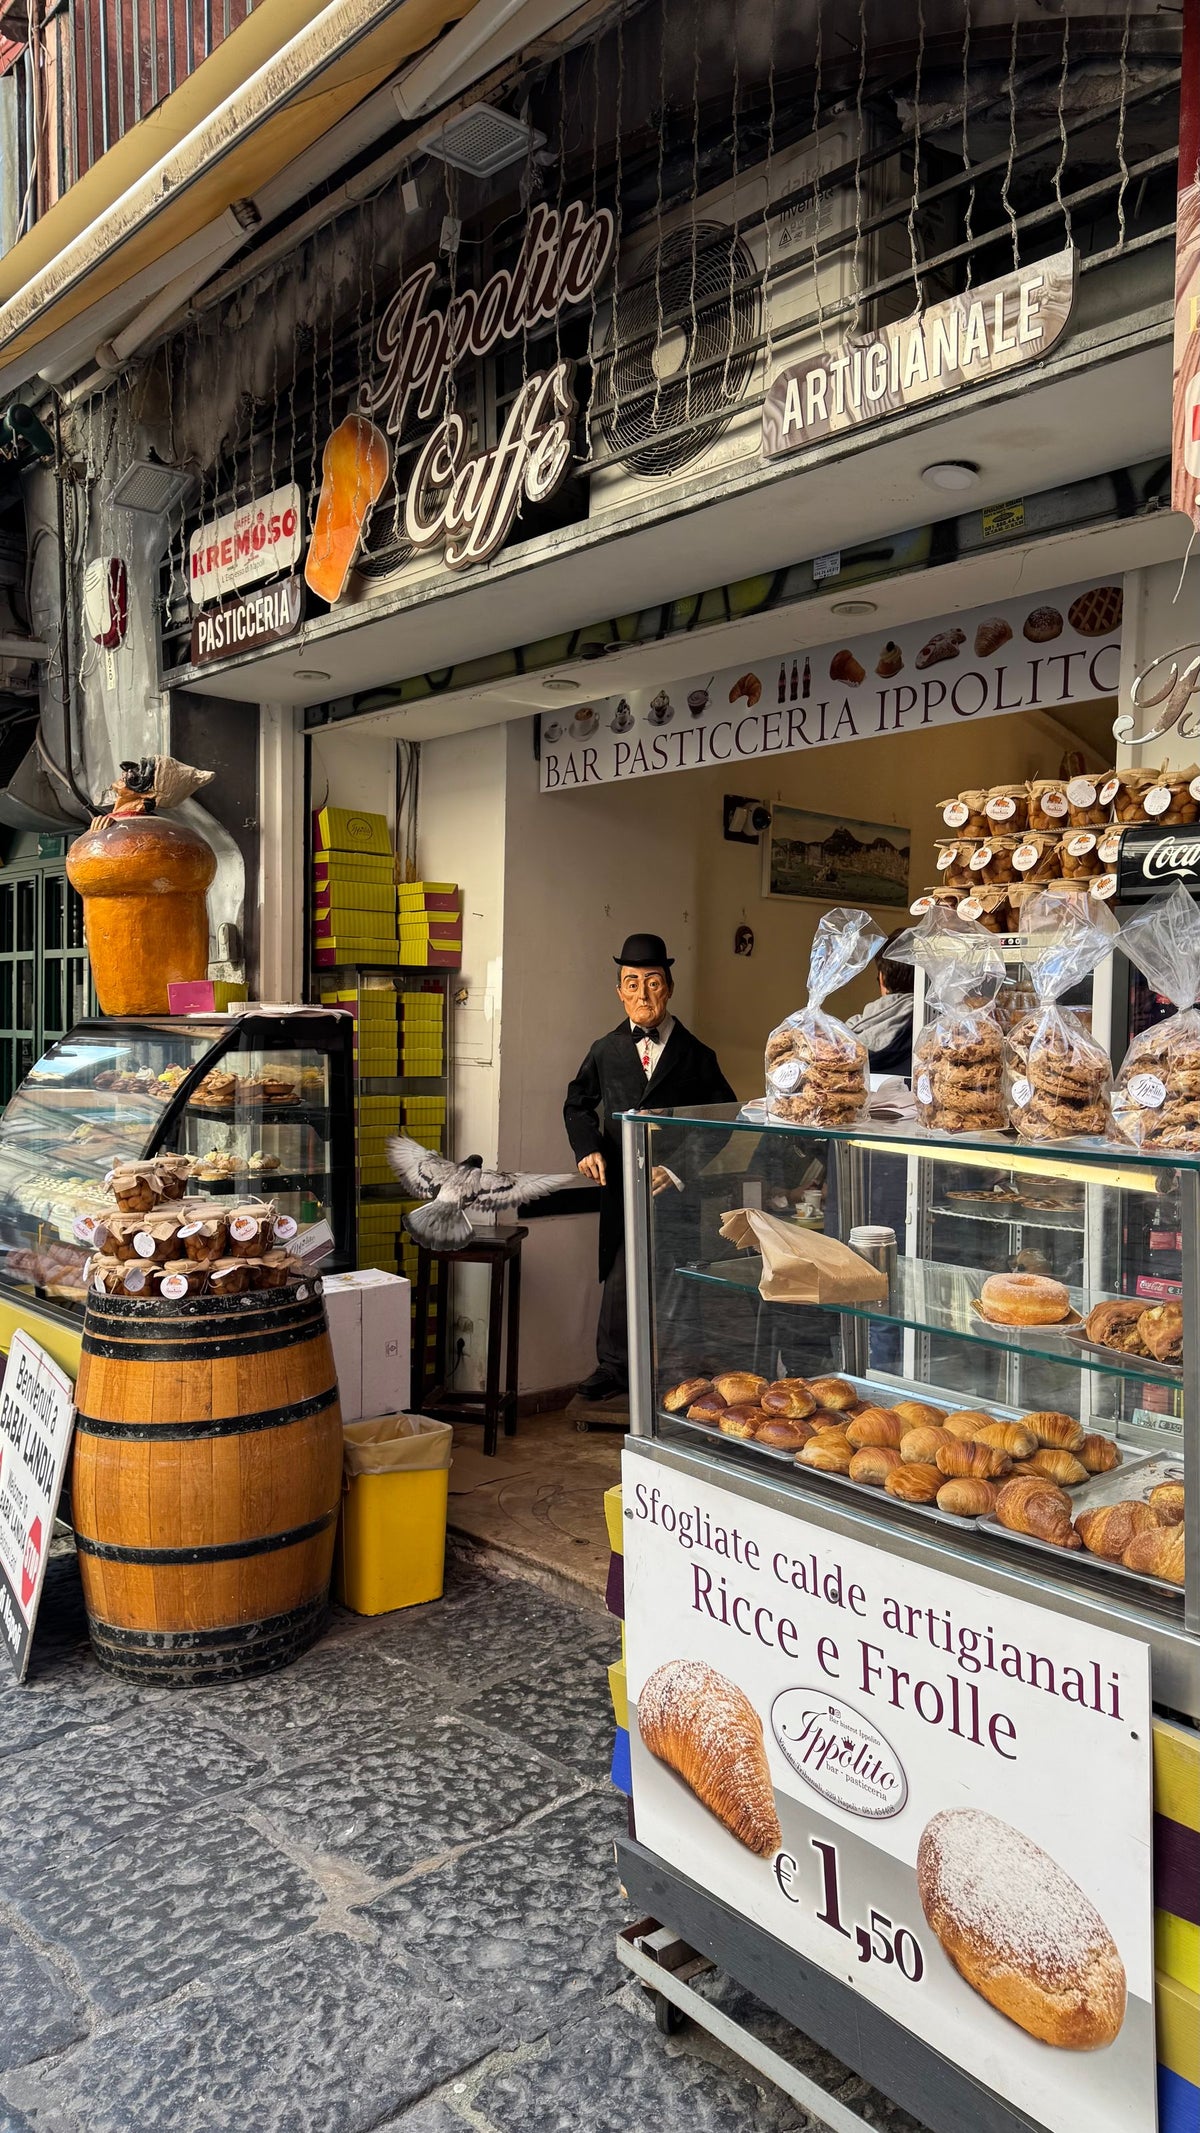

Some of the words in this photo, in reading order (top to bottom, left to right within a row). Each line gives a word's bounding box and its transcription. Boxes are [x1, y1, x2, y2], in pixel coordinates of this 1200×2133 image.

[358, 200, 614, 435] Ippolito
[782, 276, 1044, 435] ARTIGIANALE
[192, 508, 298, 579] KREMOSO
[198, 589, 289, 654] PASTICCERIA
[545, 748, 602, 788] BAR
[613, 698, 859, 777] PASTICCERIA
[874, 644, 1120, 731] IPPOLITO
[16, 1354, 55, 1428] Benvenuti
[50, 1405, 58, 1436] a
[0, 1393, 27, 1452] BABA'
[23, 1422, 56, 1503] LANDIA
[7, 1467, 23, 1510] Welcome
[24, 1536, 40, 1584] STOP
[3, 1593, 22, 1654] Napoli
[635, 1483, 760, 1570] Sfogliate
[772, 1554, 867, 1617] calde
[882, 1598, 1124, 1721] artigianali
[690, 1563, 799, 1658] Ricce
[817, 1635, 840, 1678] e
[857, 1639, 1018, 1760] Frolle
[782, 1711, 899, 1790] Ippolito
[829, 1715, 839, 1725] Bar
[859, 1729, 881, 1746] Ippolito
[826, 1761, 839, 1775] bar
[845, 1773, 887, 1801] pasticceria
[773, 1853, 799, 1903] €
[811, 1839, 923, 1982] 1,50
